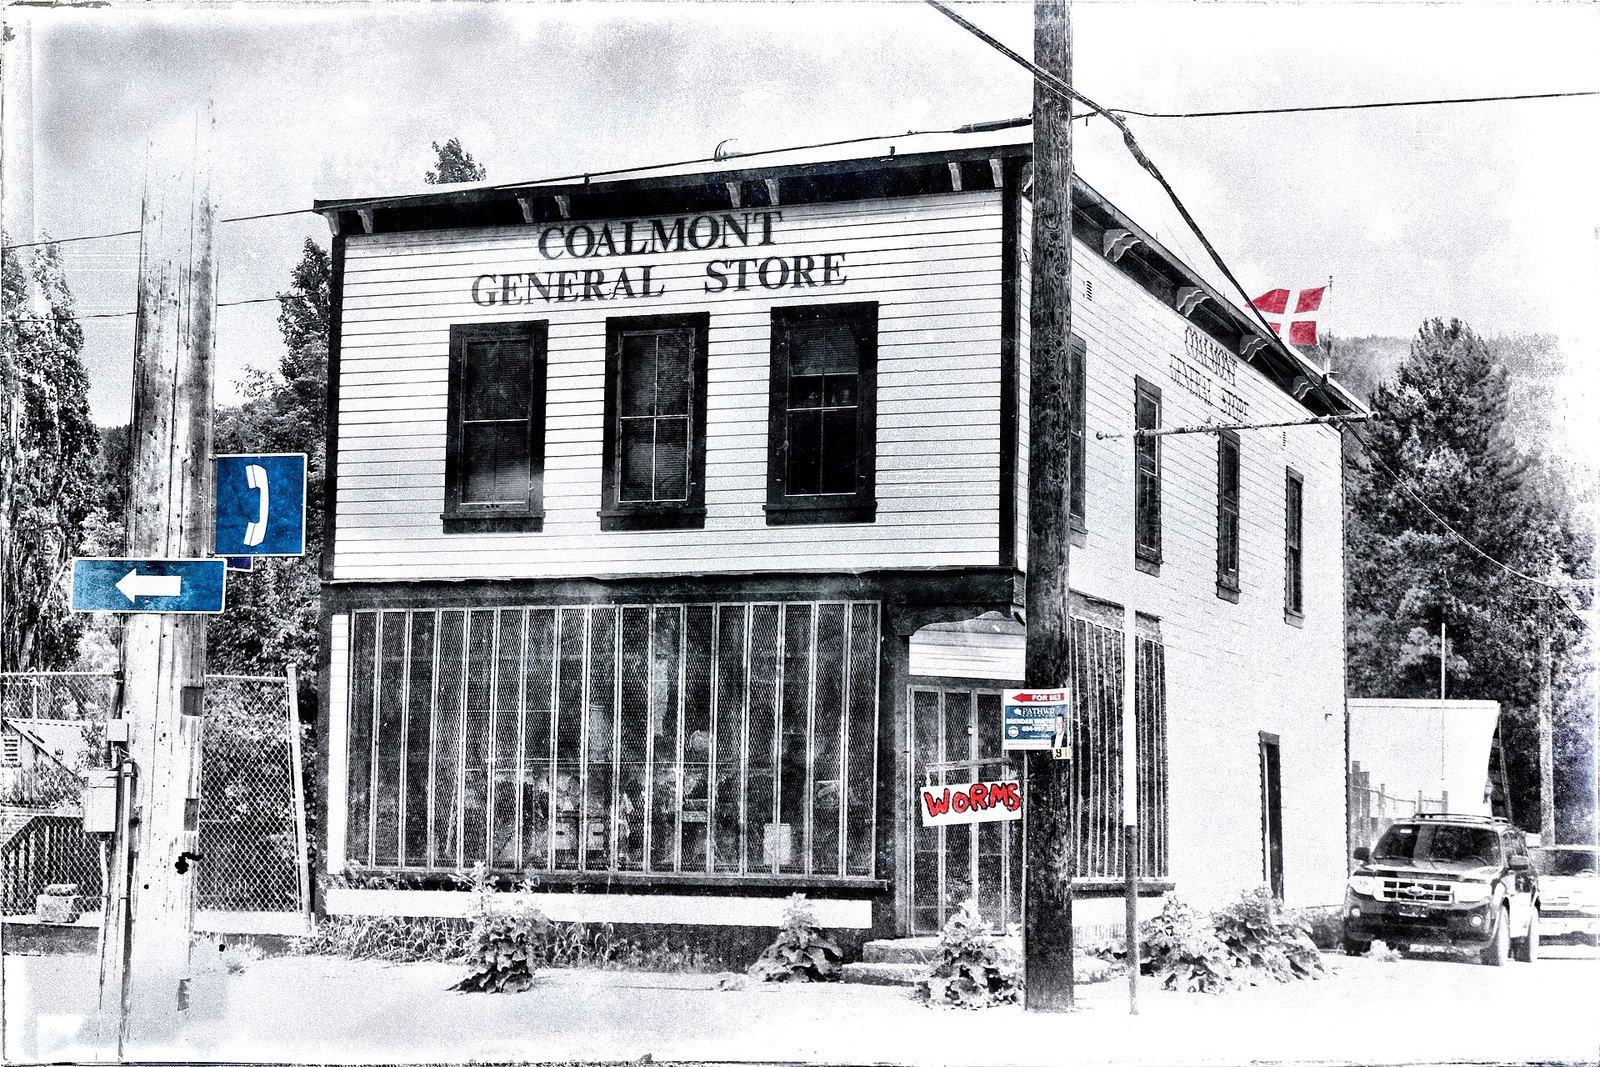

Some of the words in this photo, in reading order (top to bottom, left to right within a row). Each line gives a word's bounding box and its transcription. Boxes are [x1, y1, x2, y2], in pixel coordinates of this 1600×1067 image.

[538, 211, 783, 260] COALMONT
[471, 265, 664, 307] GENERAL
[704, 252, 847, 294] STORE
[1031, 693, 1048, 702] FOR
[923, 782, 1021, 817] WORMS
